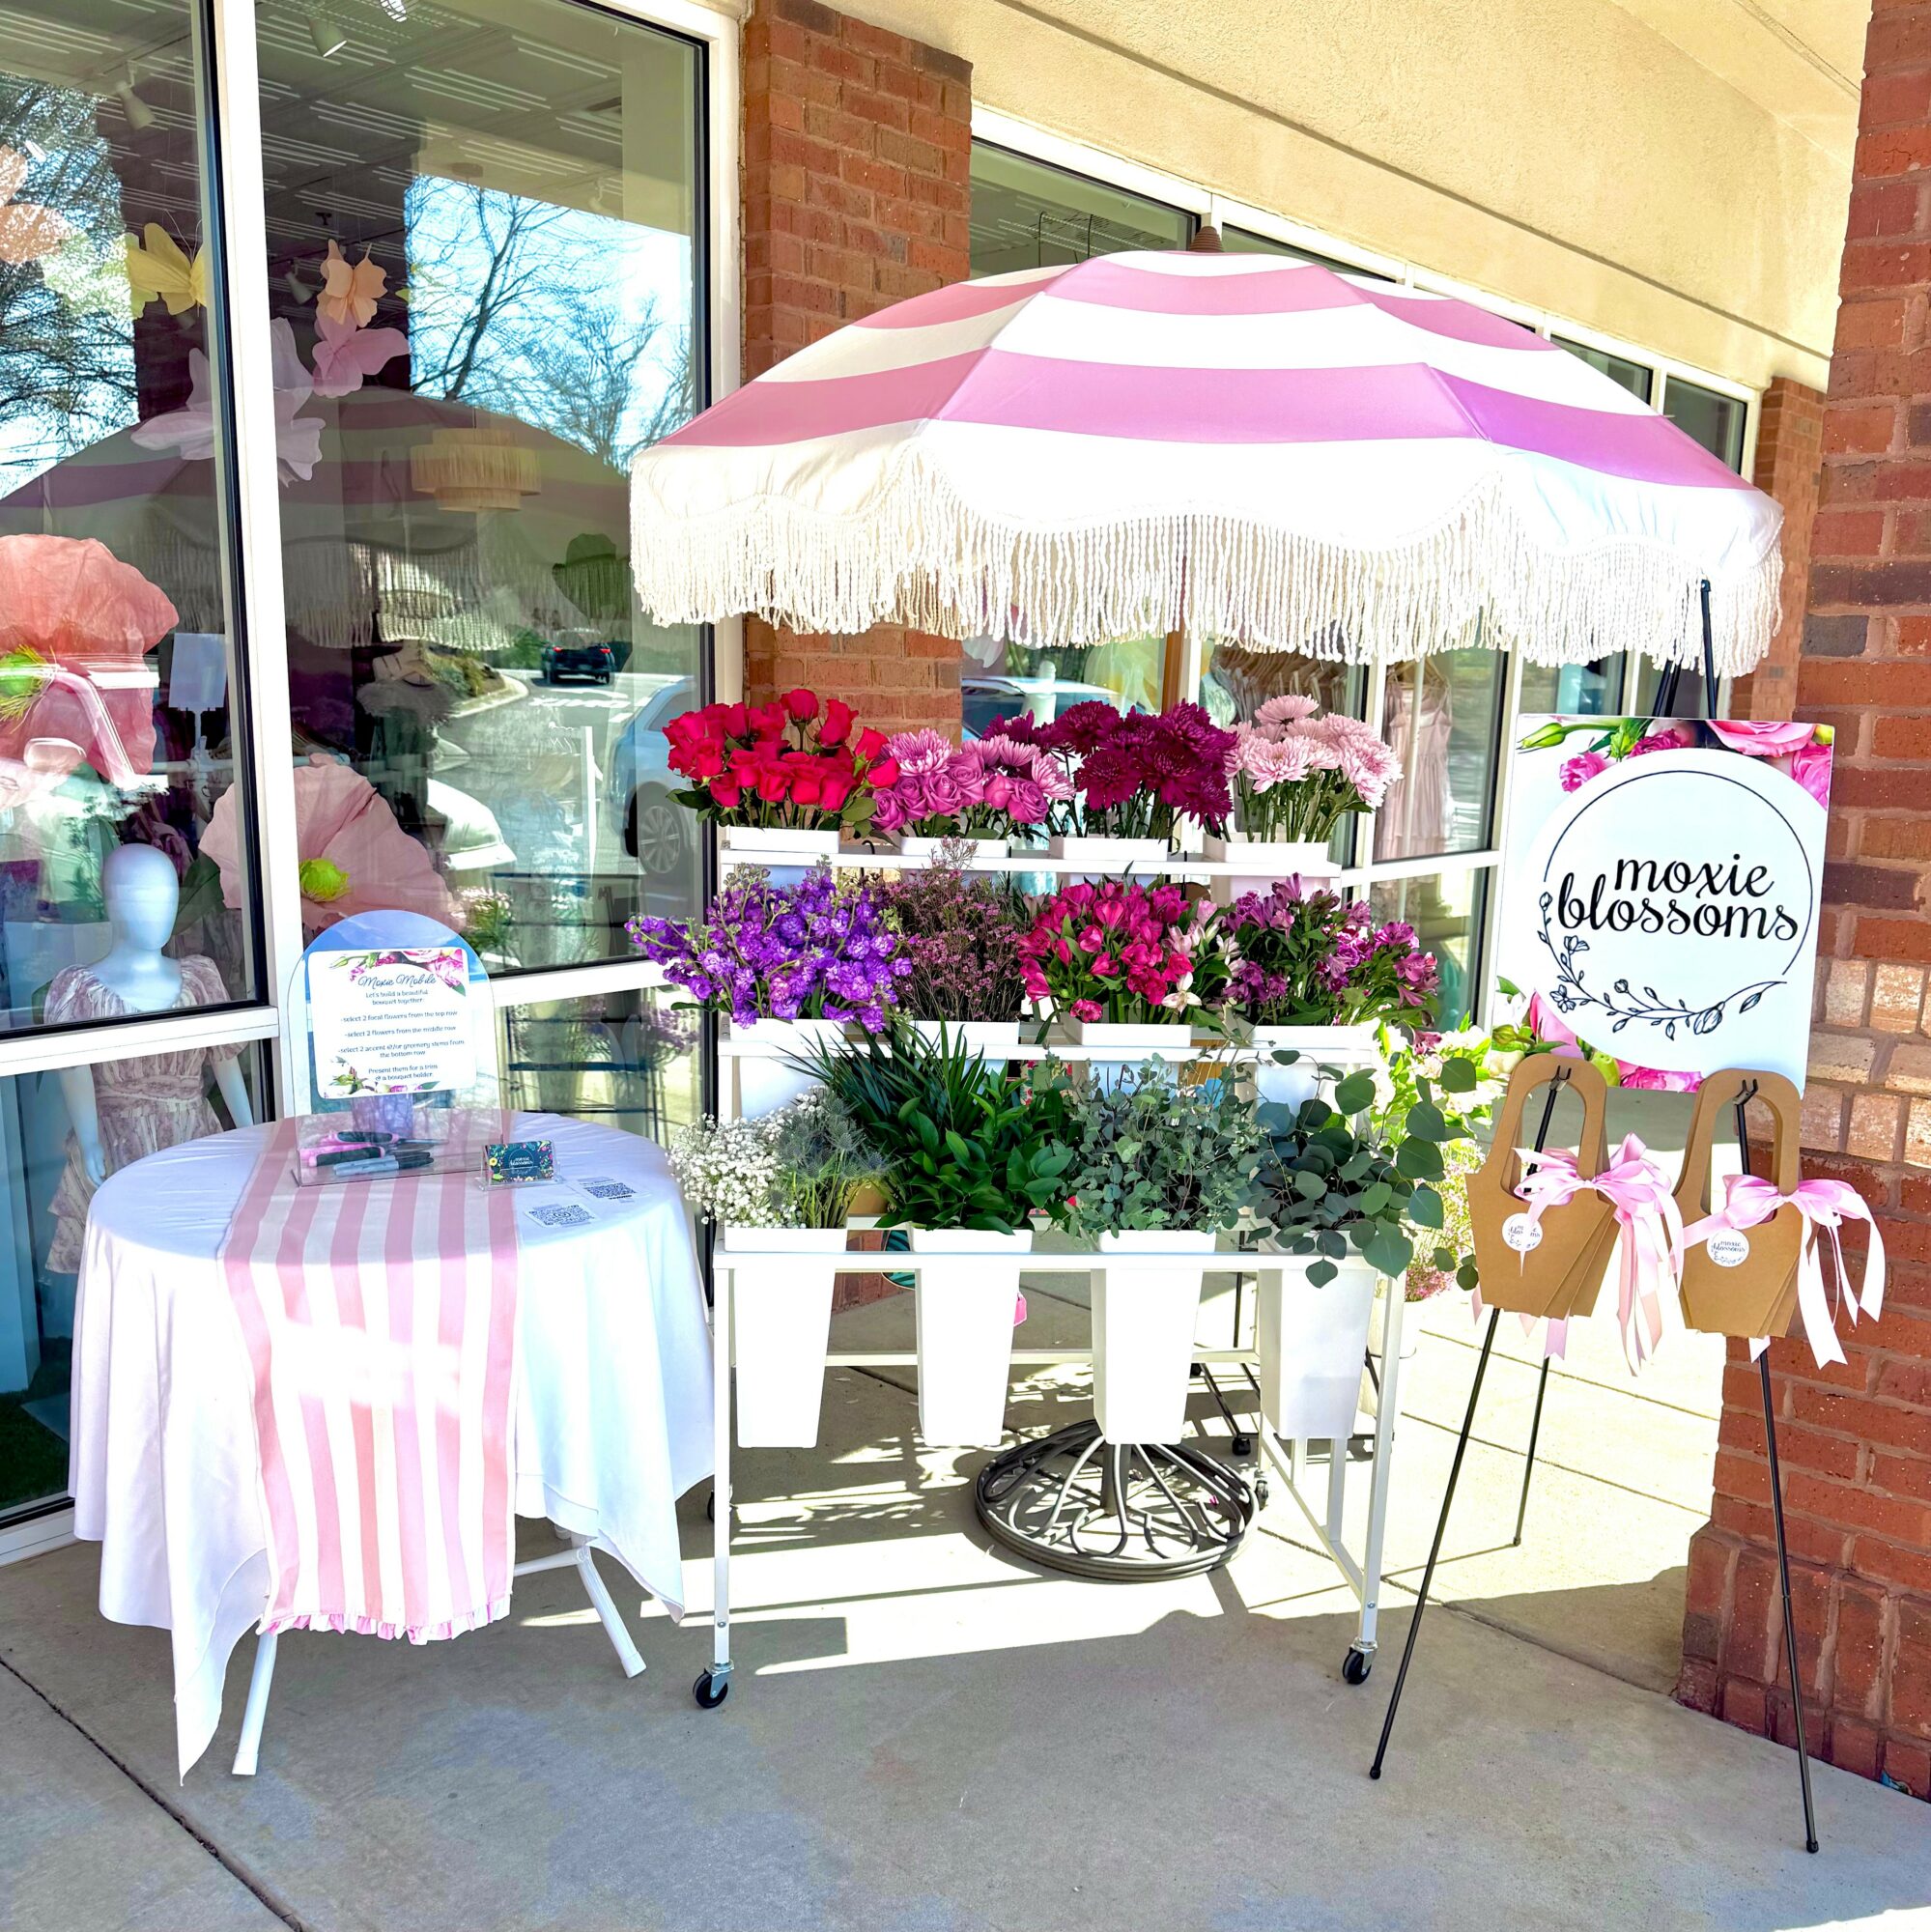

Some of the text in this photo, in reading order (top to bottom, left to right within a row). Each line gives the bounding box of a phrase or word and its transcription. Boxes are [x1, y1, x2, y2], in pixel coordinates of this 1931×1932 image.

[1614, 854, 1775, 898] moxie
[1558, 872, 1798, 941] blossoms
[358, 974, 437, 989] Moxie Mobile
[404, 1042, 430, 1051] greenery
